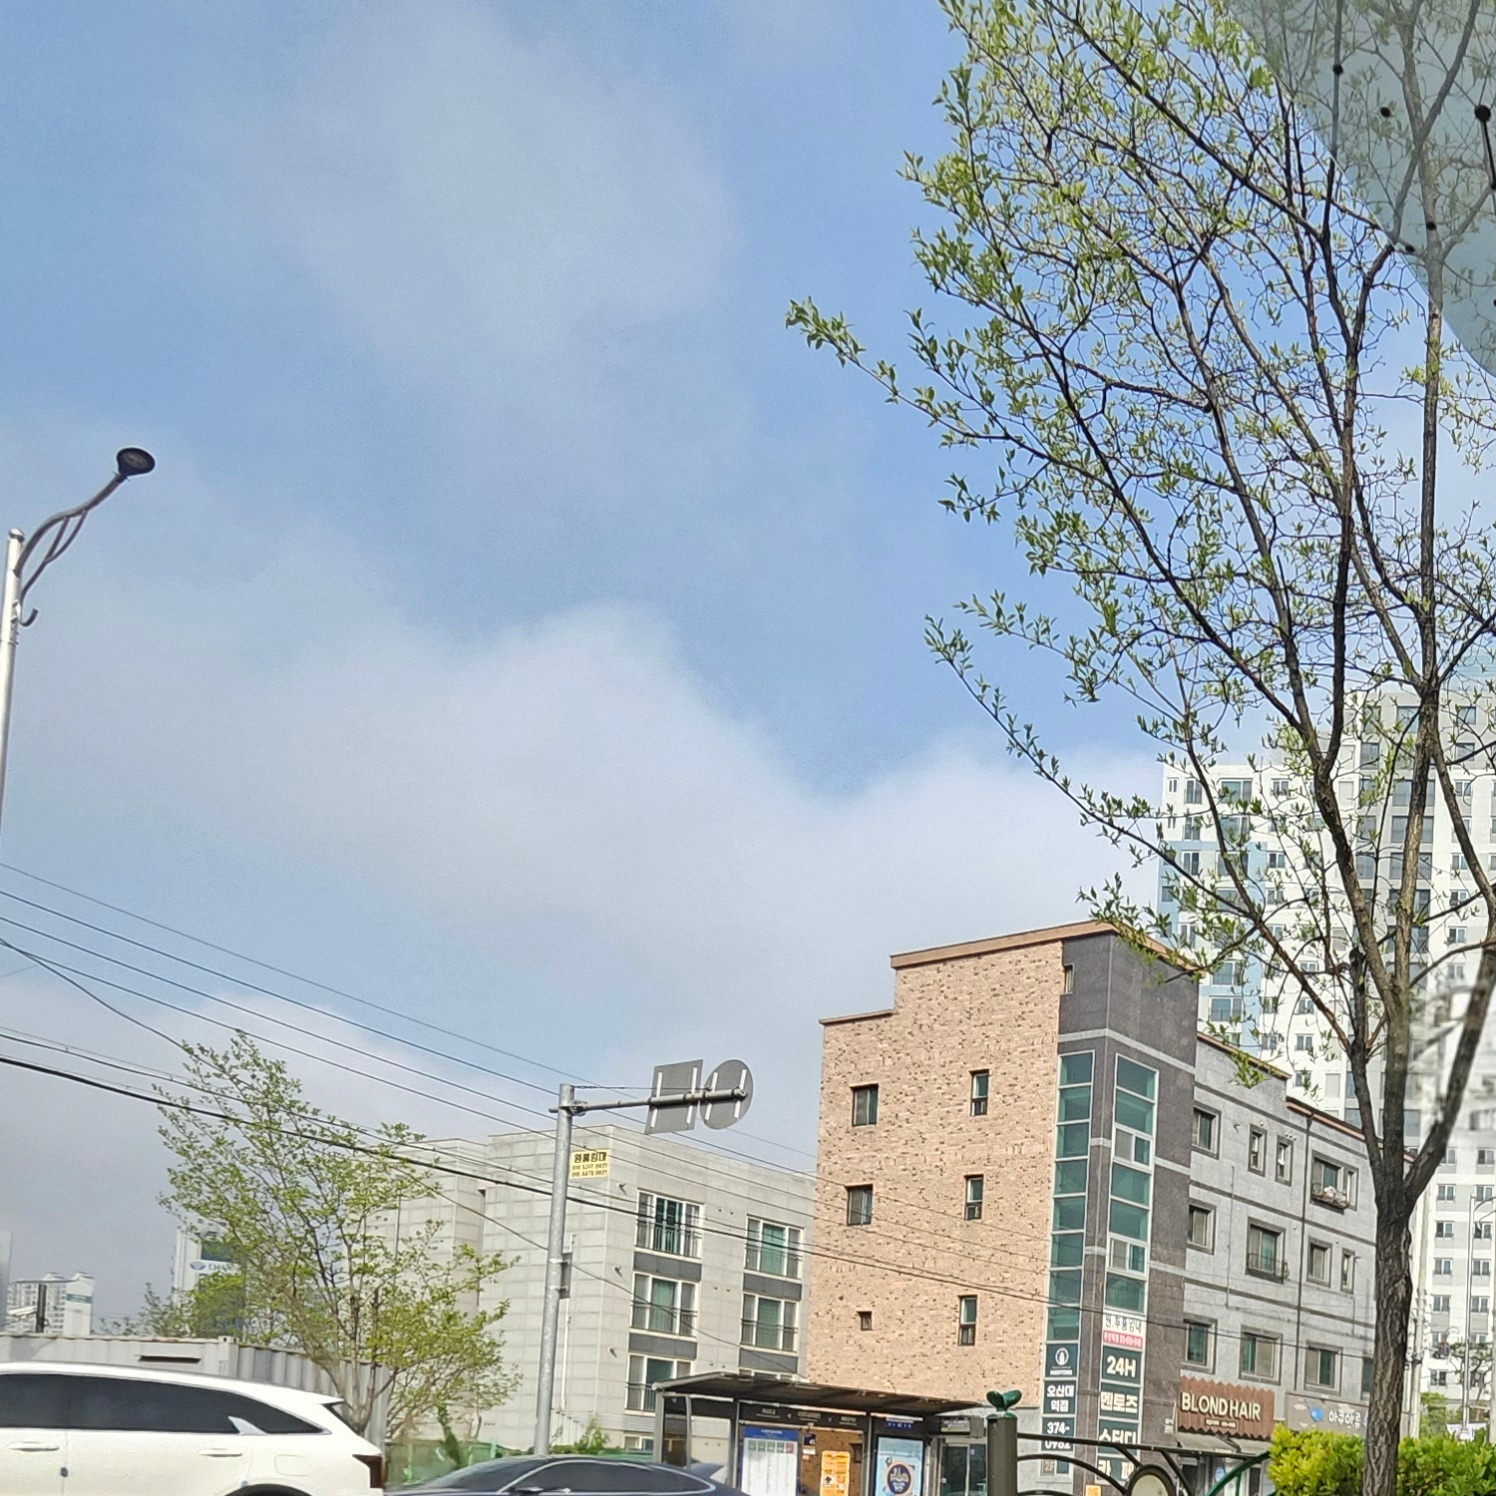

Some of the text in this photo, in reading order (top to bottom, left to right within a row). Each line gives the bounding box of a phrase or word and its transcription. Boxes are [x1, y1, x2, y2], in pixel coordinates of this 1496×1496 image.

[1106, 1355, 1137, 1378] 24H
[1100, 1391, 1139, 1414] 멘토즈
[1046, 1421, 1071, 1435] 374-
[1098, 1428, 1137, 1445] 스터디
